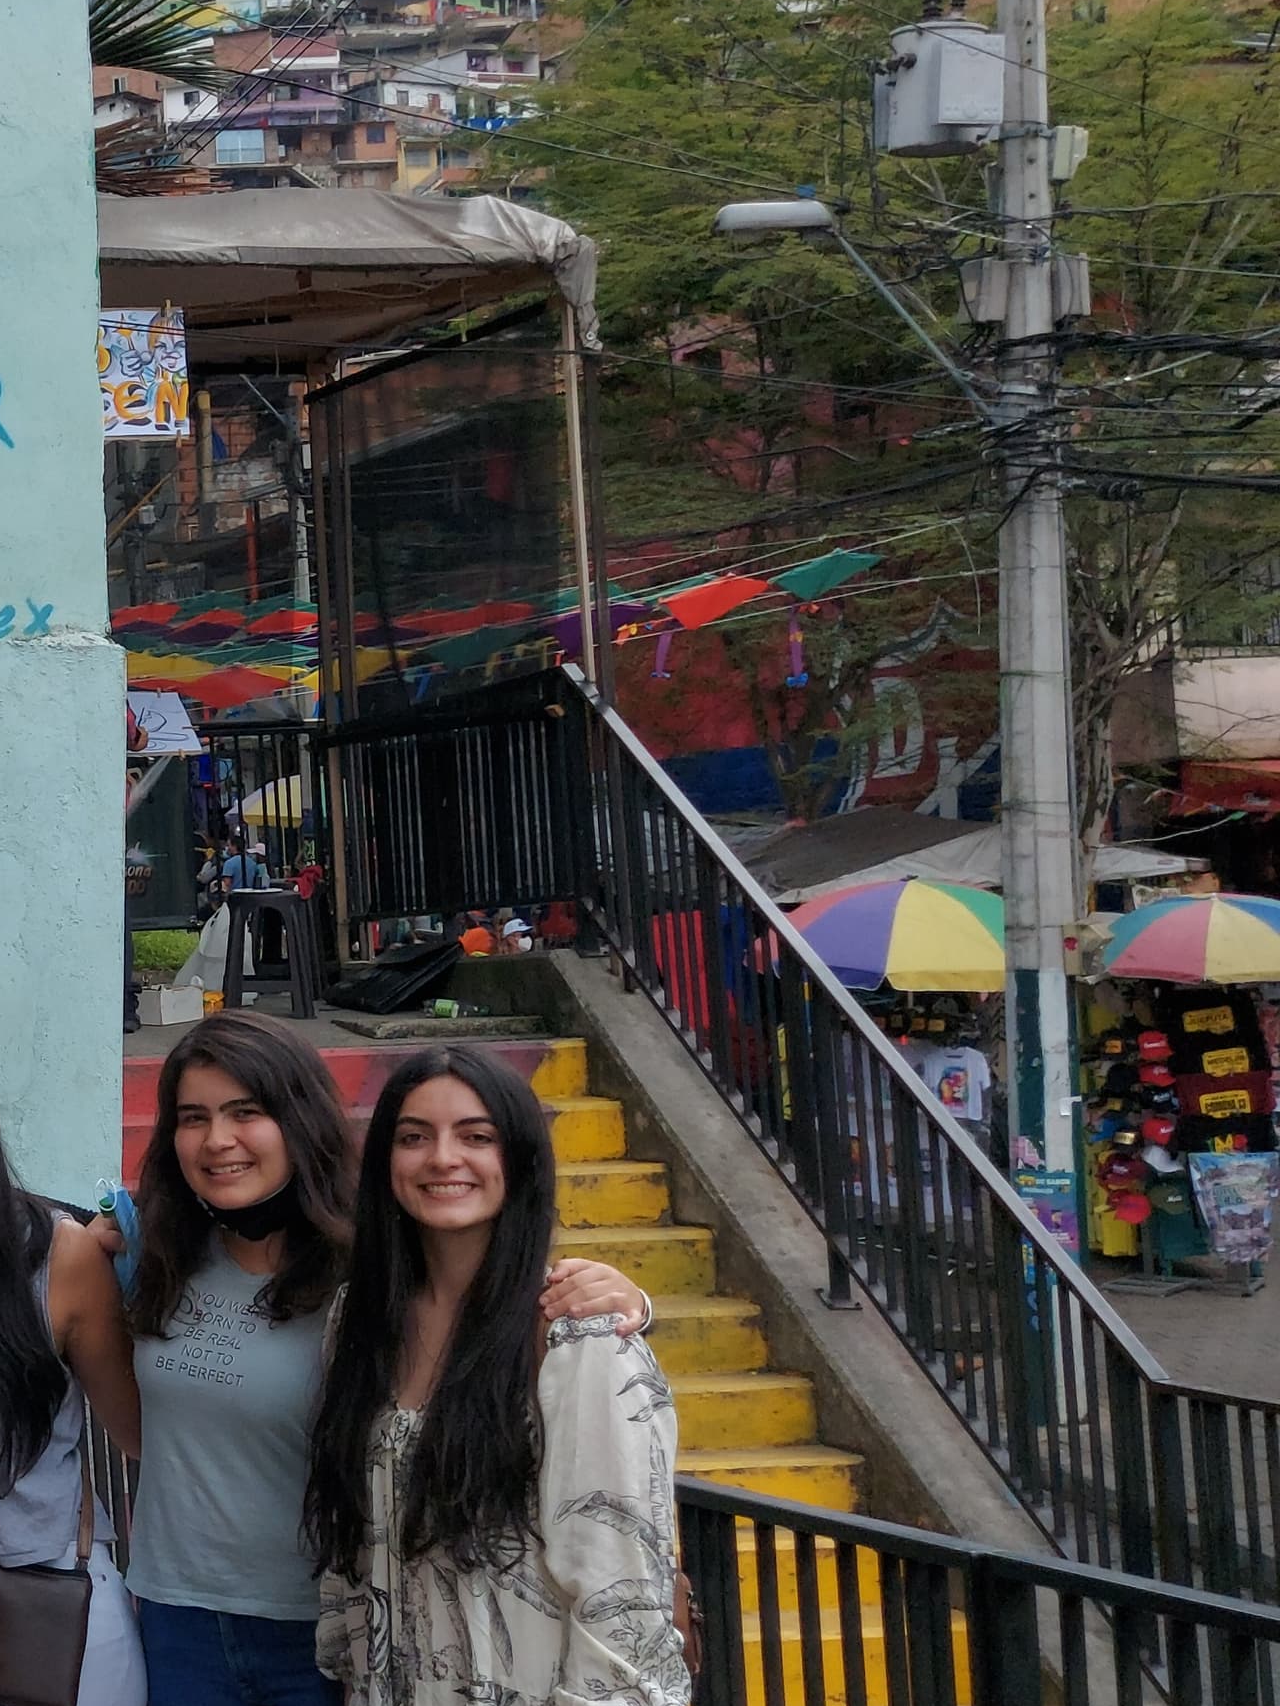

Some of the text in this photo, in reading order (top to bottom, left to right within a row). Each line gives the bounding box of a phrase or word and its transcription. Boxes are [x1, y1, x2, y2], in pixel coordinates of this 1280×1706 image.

[198, 1293, 226, 1309] YOU
[193, 1309, 256, 1334] BORN TO
[184, 1326, 241, 1350] BE REAL
[155, 1356, 175, 1371] BE
[181, 1343, 234, 1366] NOT TO
